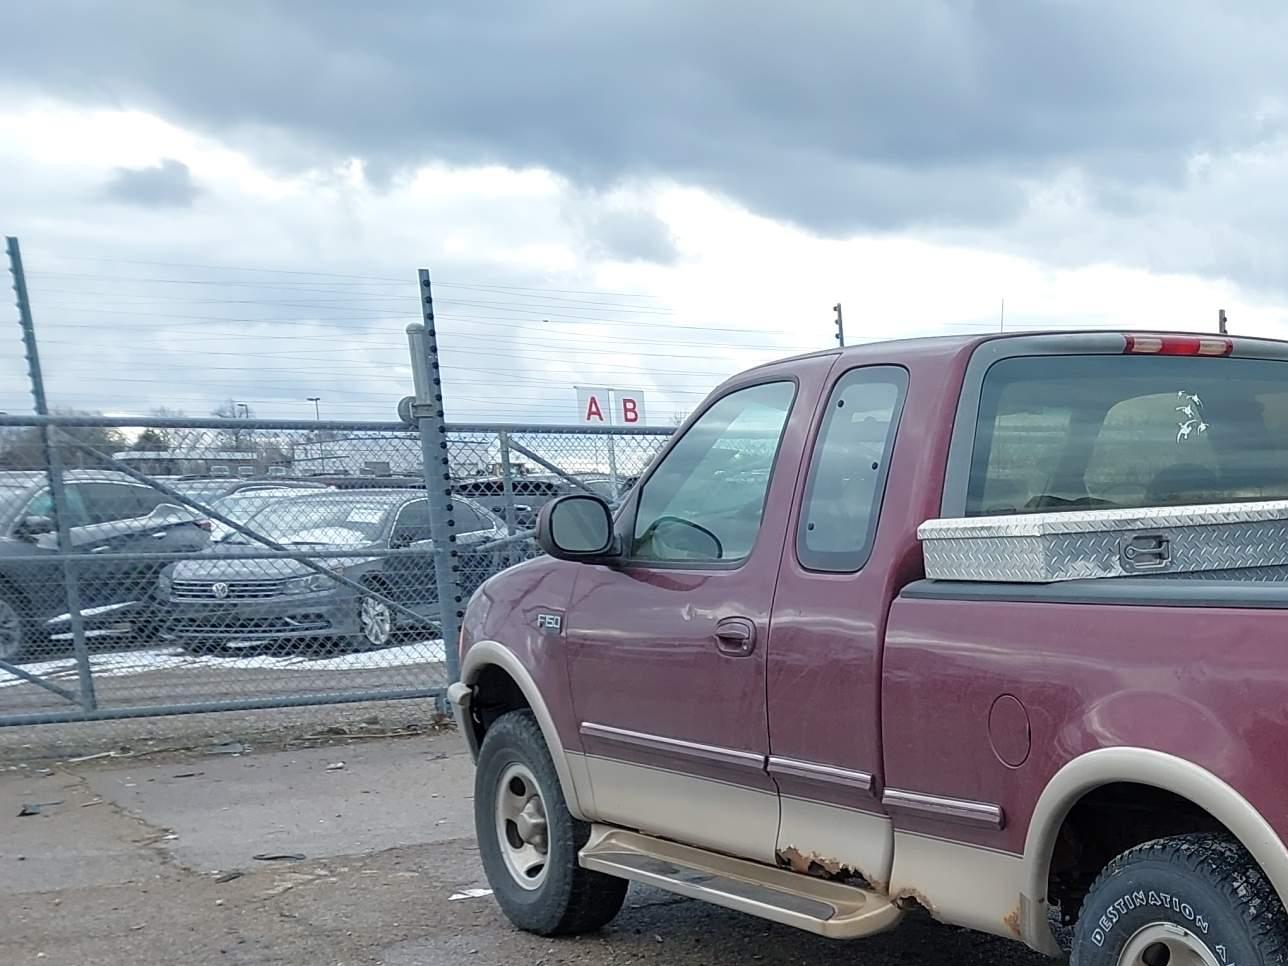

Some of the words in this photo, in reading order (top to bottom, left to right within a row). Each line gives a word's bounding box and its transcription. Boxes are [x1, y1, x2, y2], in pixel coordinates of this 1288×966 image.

[586, 396, 604, 422] A
[622, 398, 639, 423] B
[1090, 889, 1209, 947] DESTINATION
